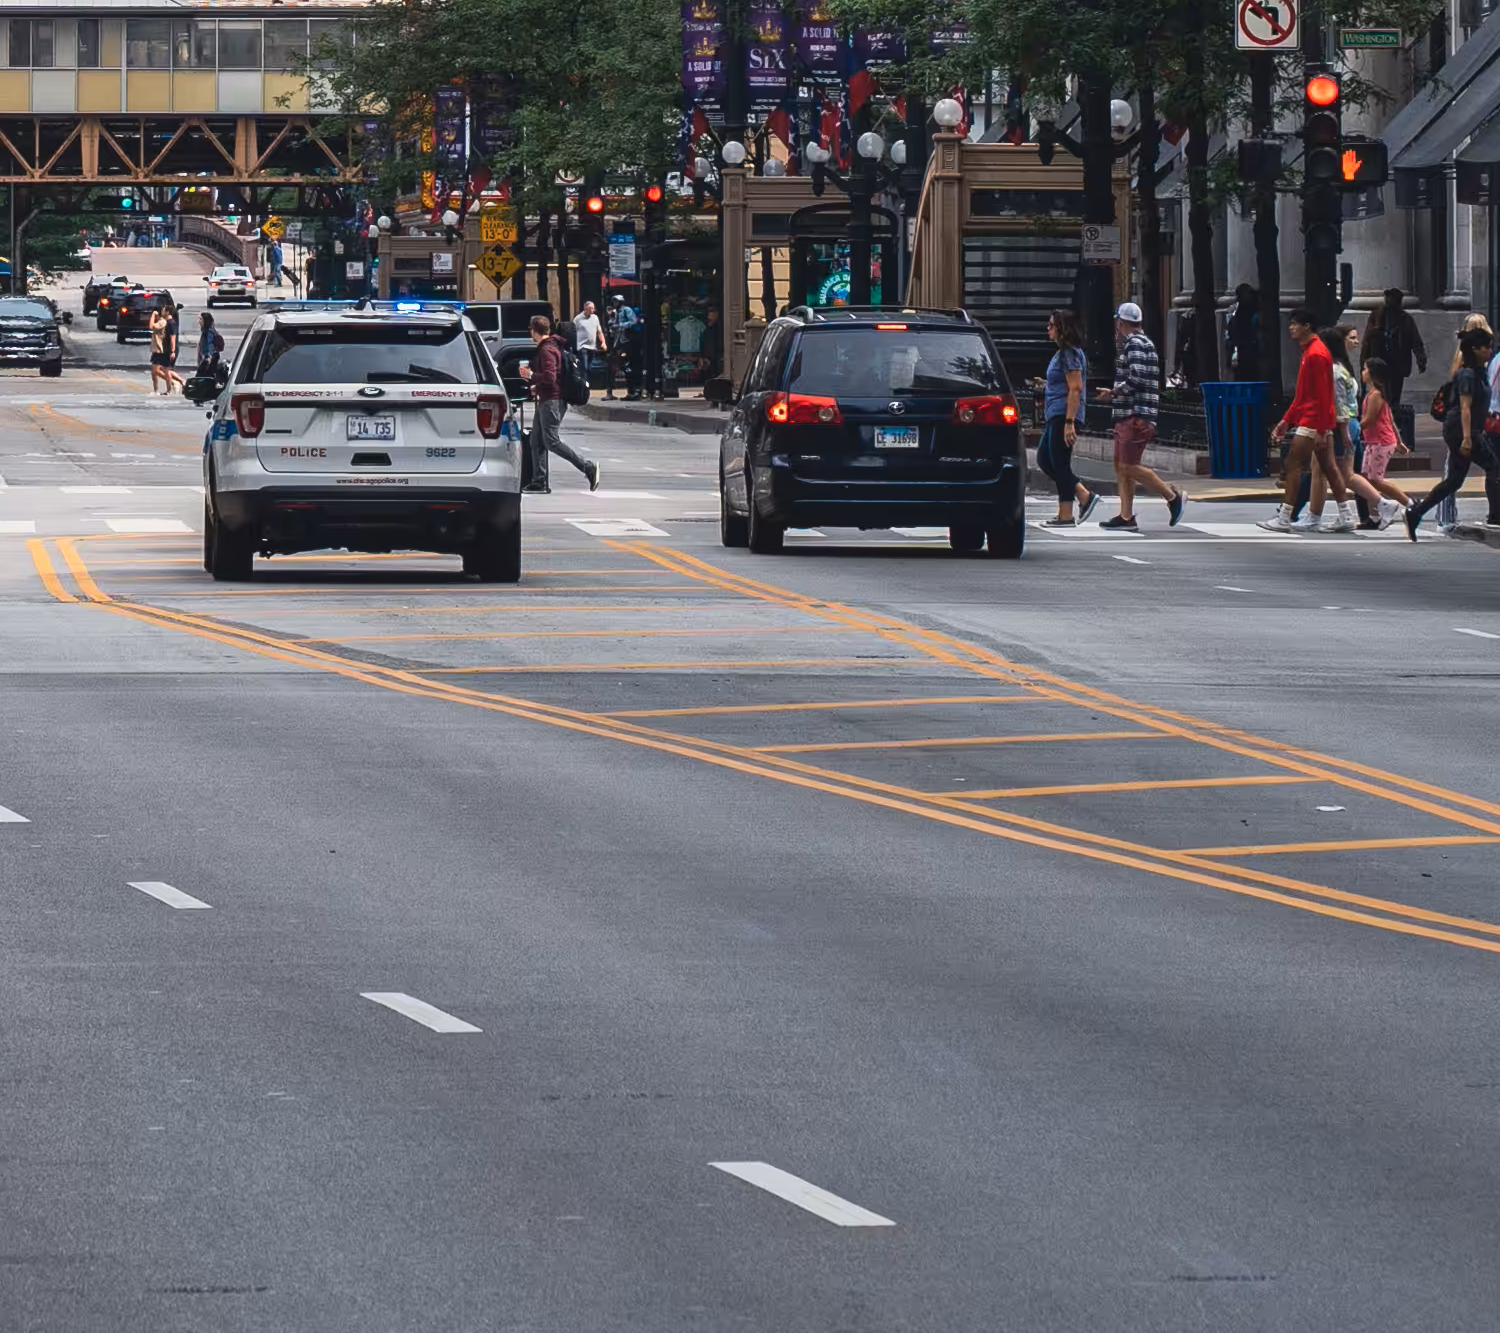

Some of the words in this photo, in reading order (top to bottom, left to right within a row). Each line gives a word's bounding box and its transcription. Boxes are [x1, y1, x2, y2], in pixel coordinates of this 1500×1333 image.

[1345, 33, 1397, 44] WASHINGTON
[749, 48, 786, 71] SIX
[357, 422, 369, 435] 14
[373, 421, 392, 436] 735
[280, 447, 328, 458] POLICE
